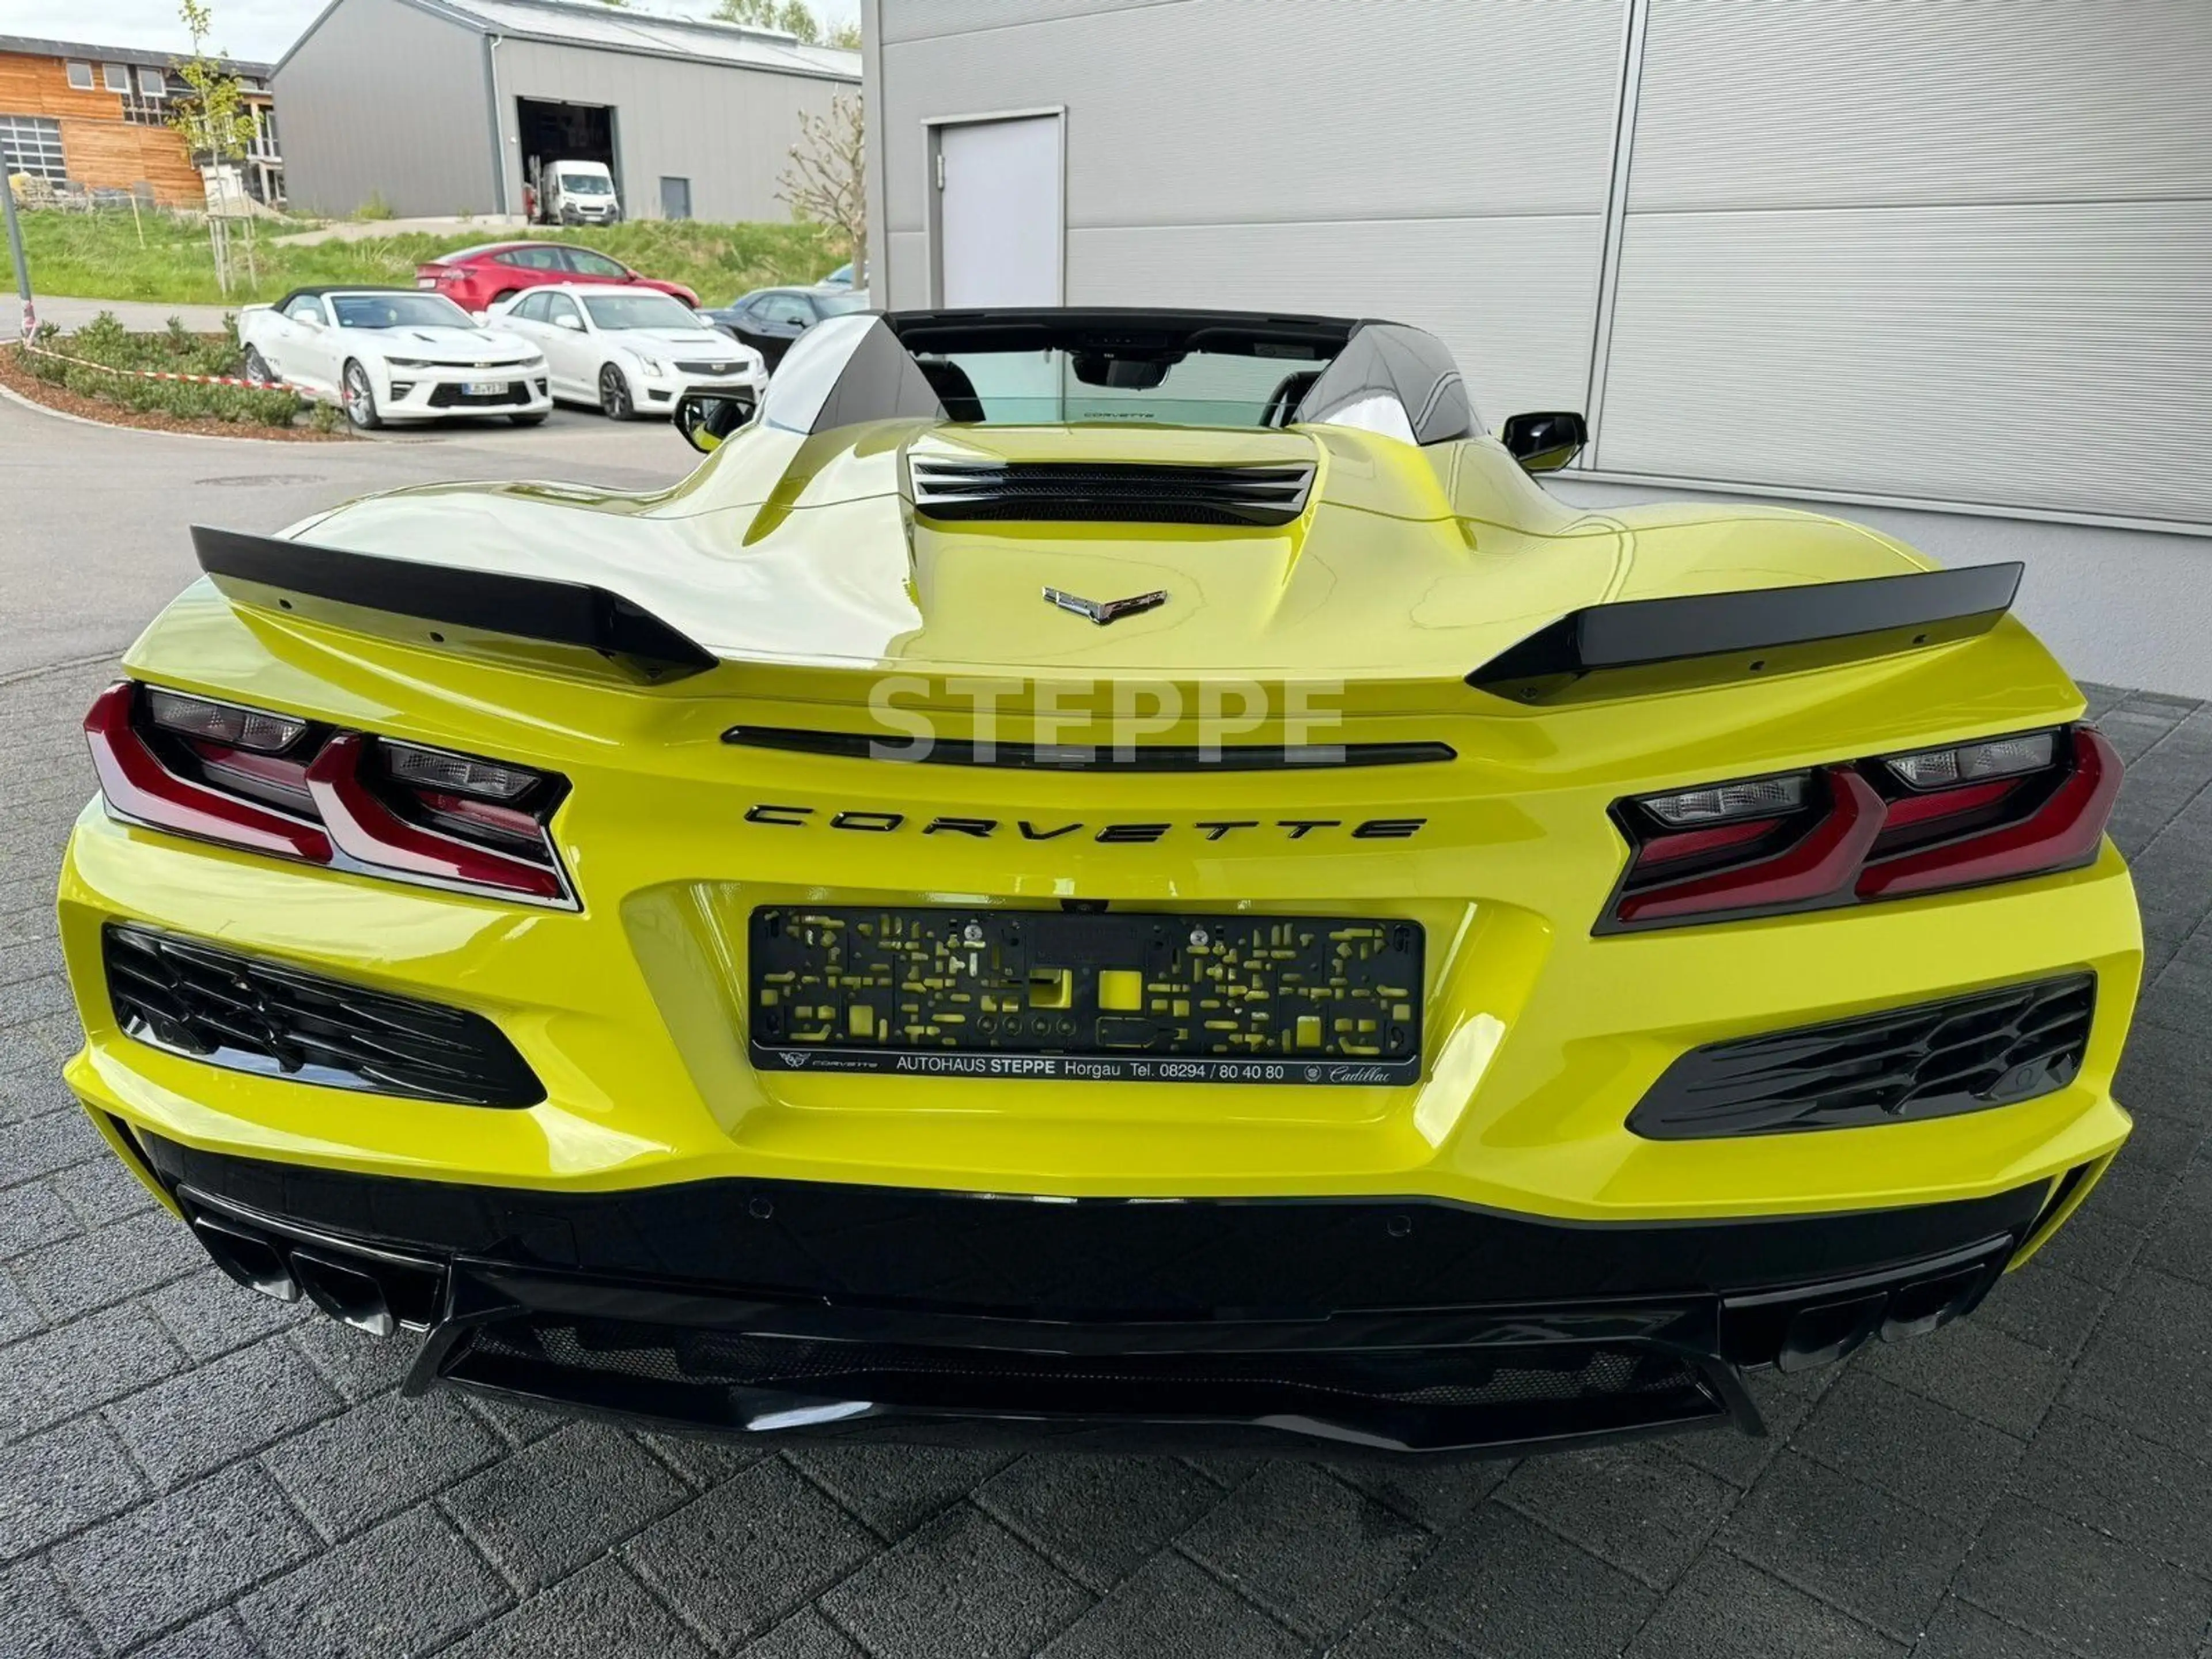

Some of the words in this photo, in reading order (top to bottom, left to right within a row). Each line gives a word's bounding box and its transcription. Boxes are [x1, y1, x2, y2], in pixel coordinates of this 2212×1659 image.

[743, 805, 1428, 843] CORVETTE
[896, 1056, 986, 1073] AUTOHAUS
[991, 1059, 1055, 1074] STEPPE
[1065, 1061, 1120, 1078] Horgau
[1130, 1063, 1154, 1077] Tel.
[1160, 1063, 1205, 1078] 08294
[1219, 1065, 1237, 1078] 80
[1243, 1066, 1260, 1079] 40
[1266, 1066, 1283, 1079] 80
[1329, 1066, 1391, 1083] Cadillac
